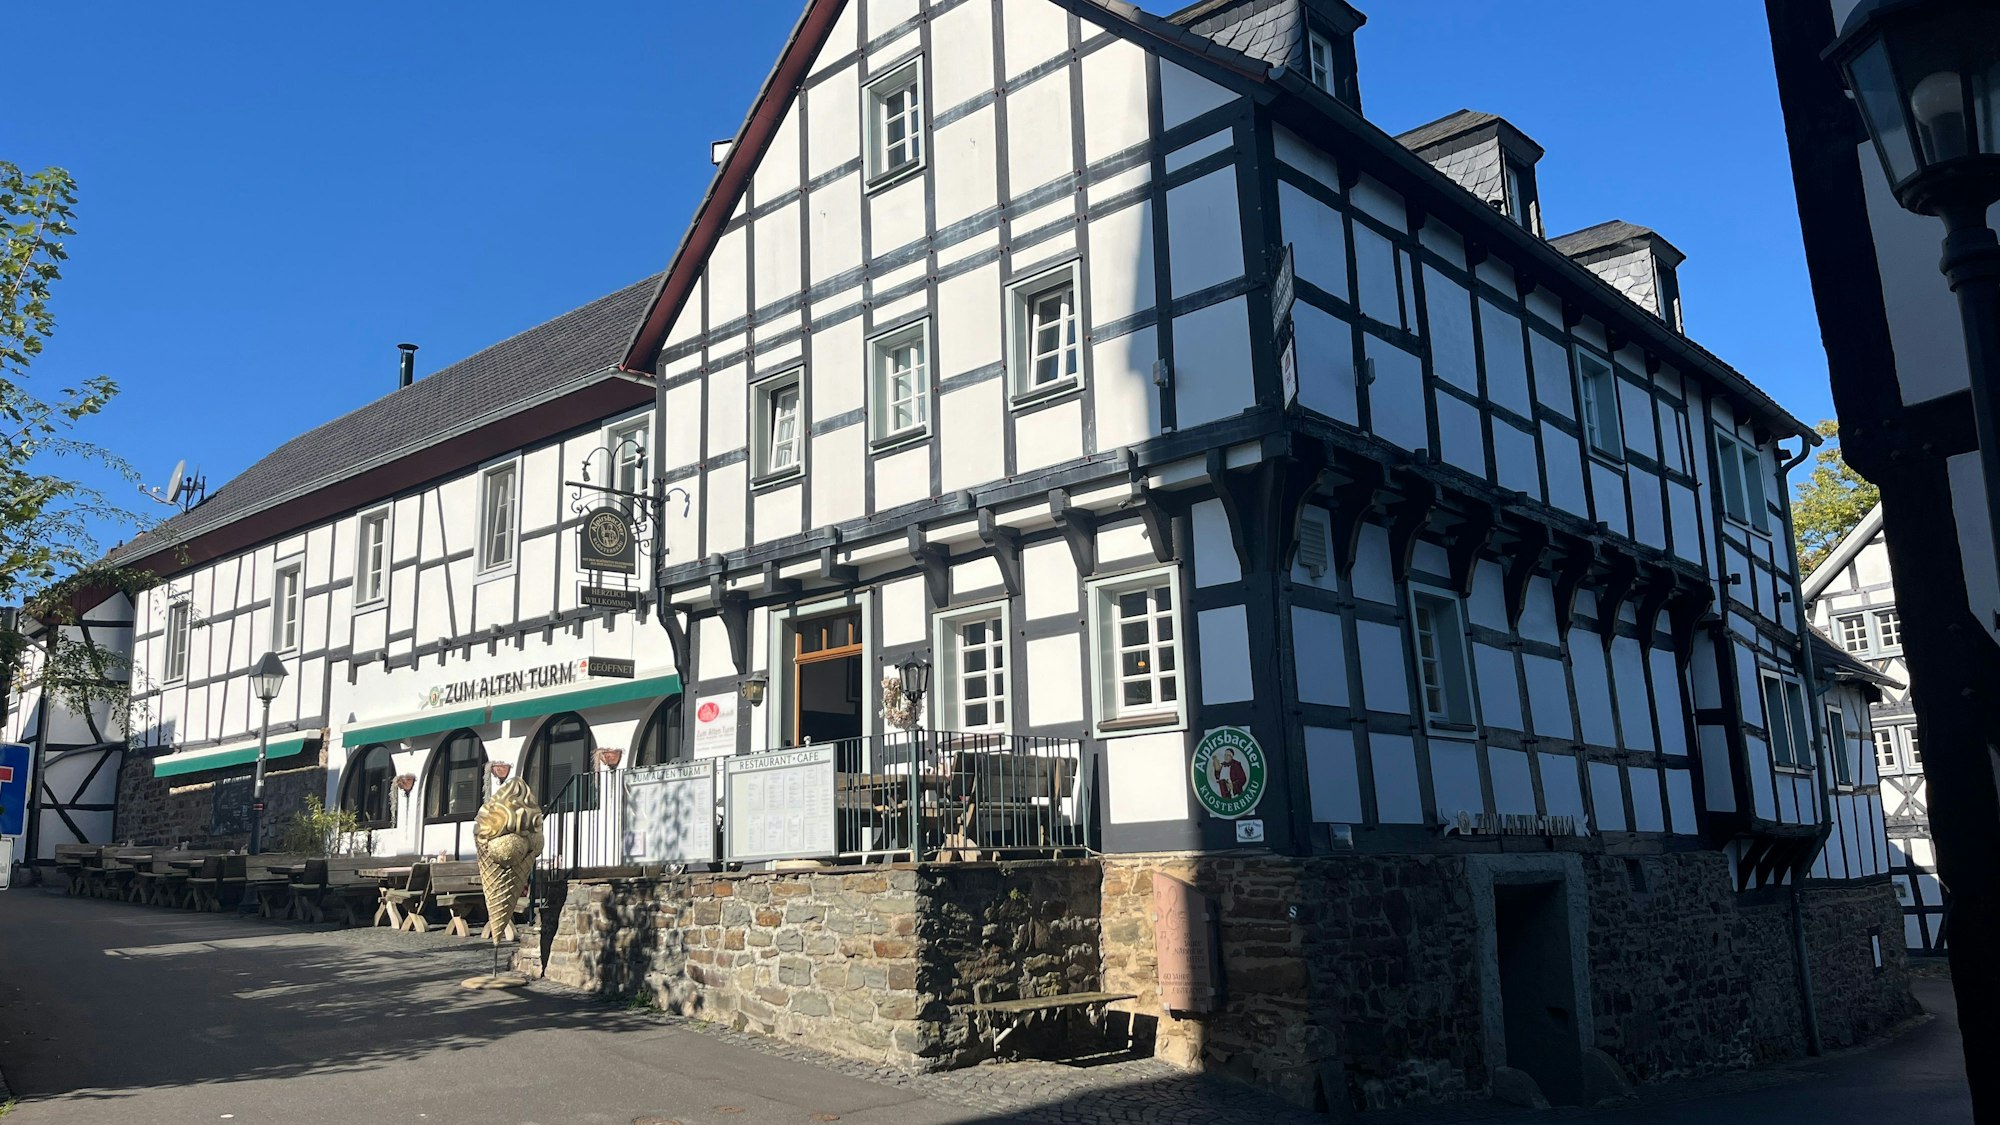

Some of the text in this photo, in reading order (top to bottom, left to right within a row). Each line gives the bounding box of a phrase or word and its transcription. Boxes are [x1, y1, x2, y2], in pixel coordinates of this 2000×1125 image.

[591, 514, 624, 537] Alpirsbacher
[585, 597, 632, 608] WILLKOMMEN
[591, 589, 626, 599] HERZLICH
[590, 662, 633, 674] GEÖFFNET
[445, 661, 573, 704] ZUM ALTEN TURM
[1195, 730, 1260, 773] Alpirsbacher
[739, 755, 791, 770] RESTAURANT
[633, 766, 701, 782] ZUM ALTEN TURM
[1199, 780, 1260, 812] KLOSTERBRÄU
[1475, 813, 1575, 836] ZUM ALTEN TURM
